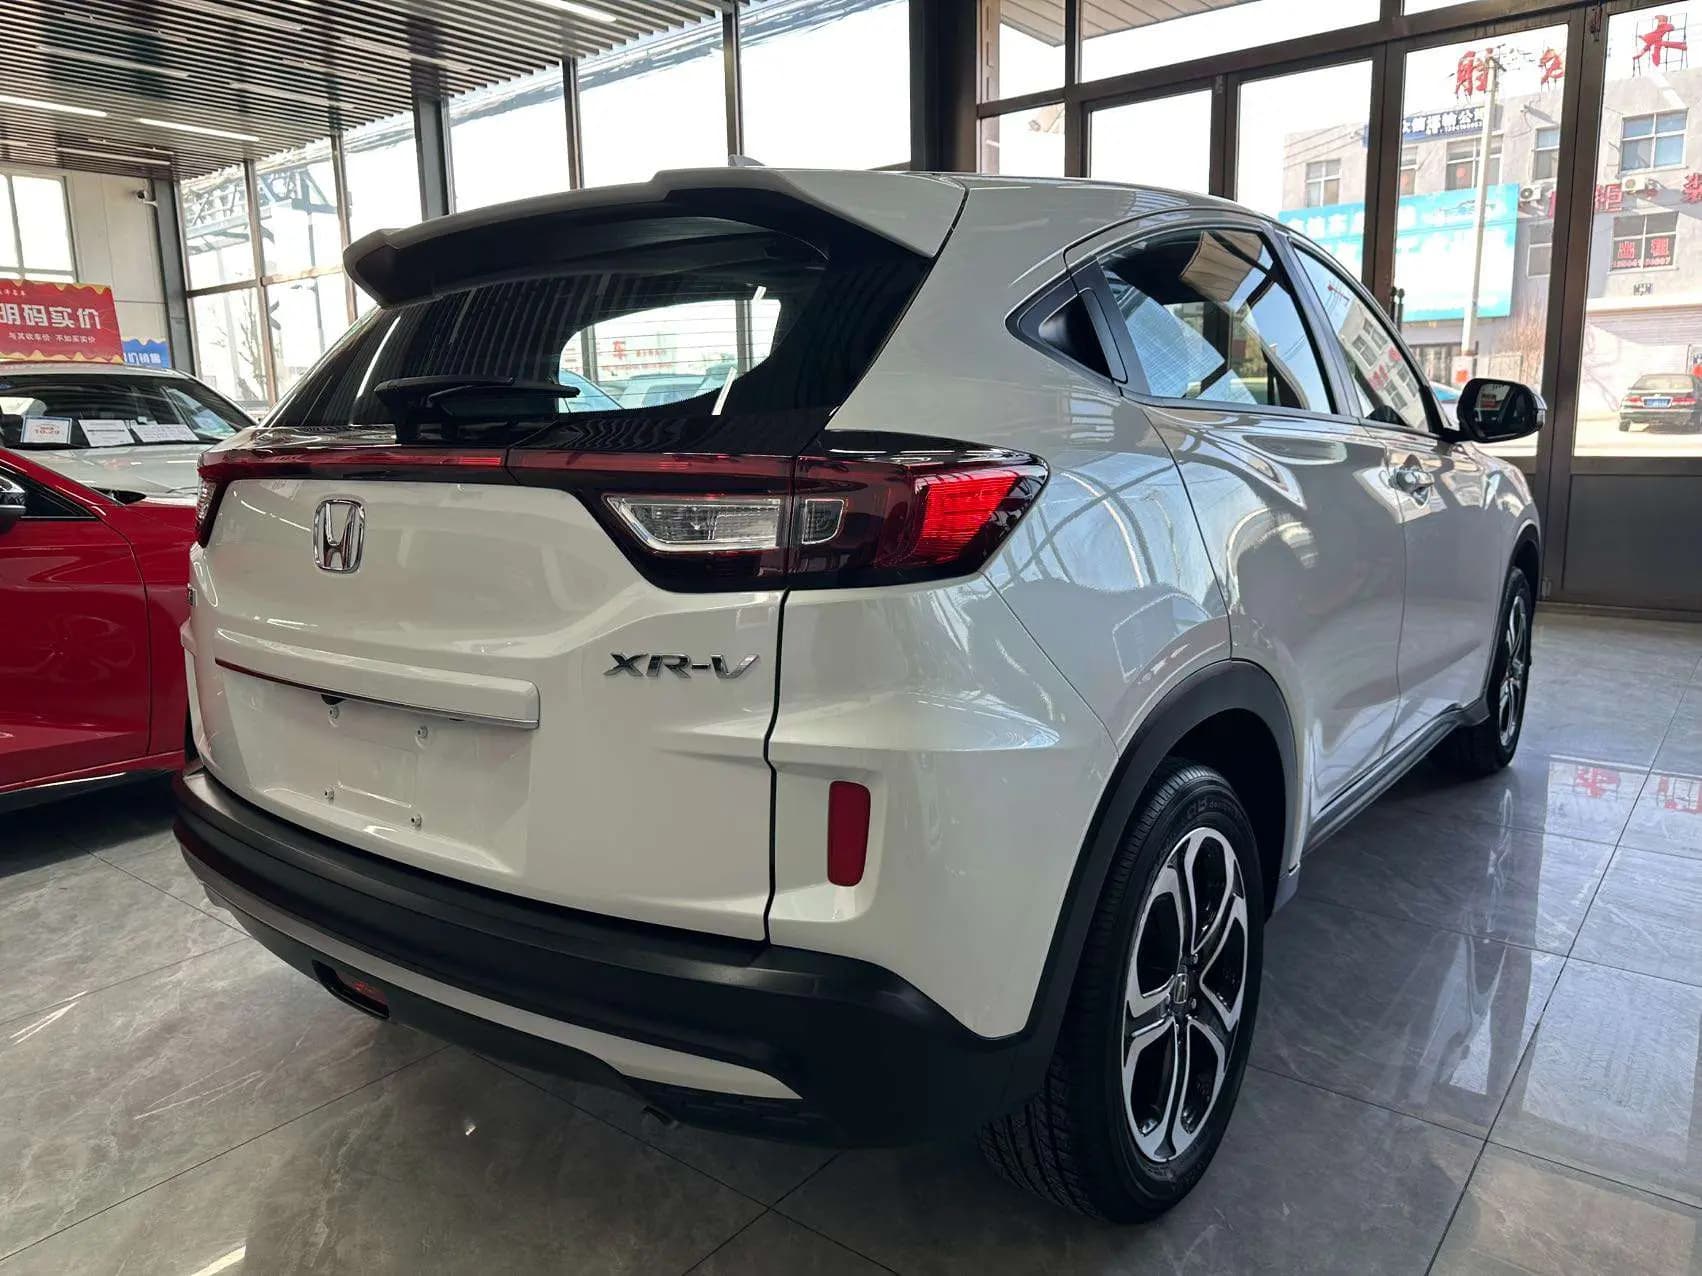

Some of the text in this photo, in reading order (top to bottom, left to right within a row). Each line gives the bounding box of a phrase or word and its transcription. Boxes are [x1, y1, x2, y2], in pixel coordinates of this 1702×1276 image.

[0, 303, 101, 330] 明码实价
[603, 653, 760, 680] XR-V
